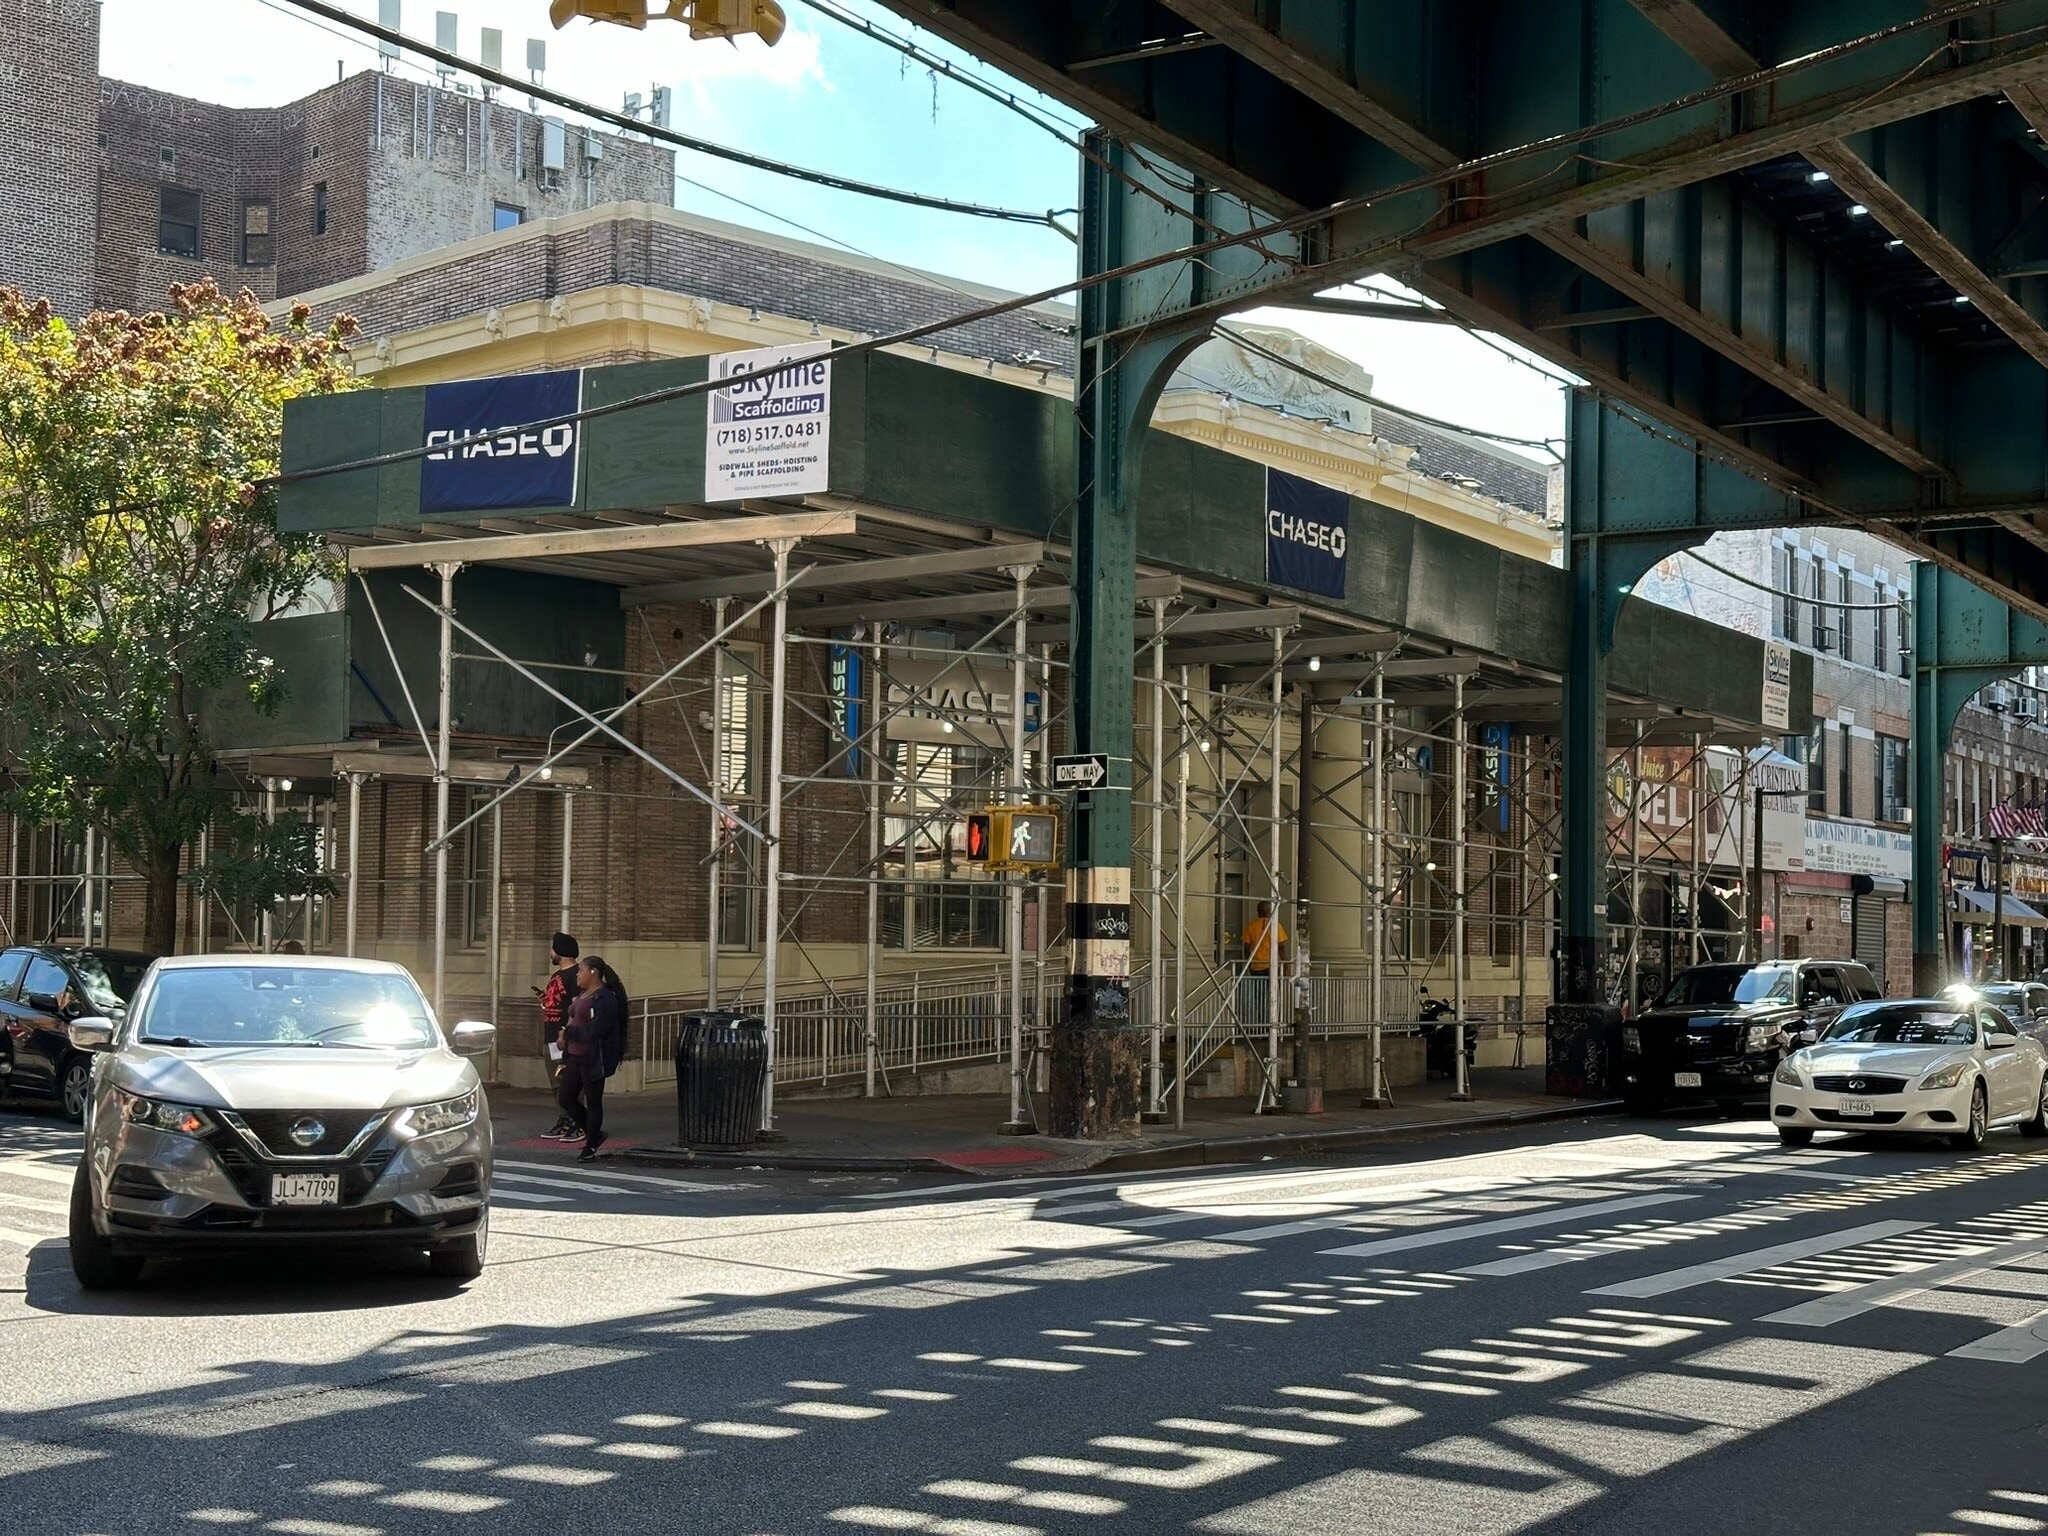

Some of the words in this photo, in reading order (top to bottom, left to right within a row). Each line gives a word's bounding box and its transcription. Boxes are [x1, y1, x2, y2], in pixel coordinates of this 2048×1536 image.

[732, 357, 825, 399] Skyline
[735, 399, 820, 417] Scaffolding
[427, 427, 539, 460] CHASE
[717, 427, 751, 446] (718)
[755, 422, 821, 441] 517.0481
[728, 441, 809, 454] www.SkylineScaffold.net
[719, 461, 754, 471] SIDEWALK
[757, 459, 779, 468] SHEDS
[783, 456, 818, 465] HOISTING
[757, 465, 805, 475] SCAFFOLDING
[1269, 509, 1331, 552] CHASE
[832, 659, 846, 741] CHASE
[888, 684, 1011, 726] CHASE
[1061, 766, 1076, 779] ONE
[1083, 765, 1100, 778] WAY
[1640, 755, 1665, 779] Juice
